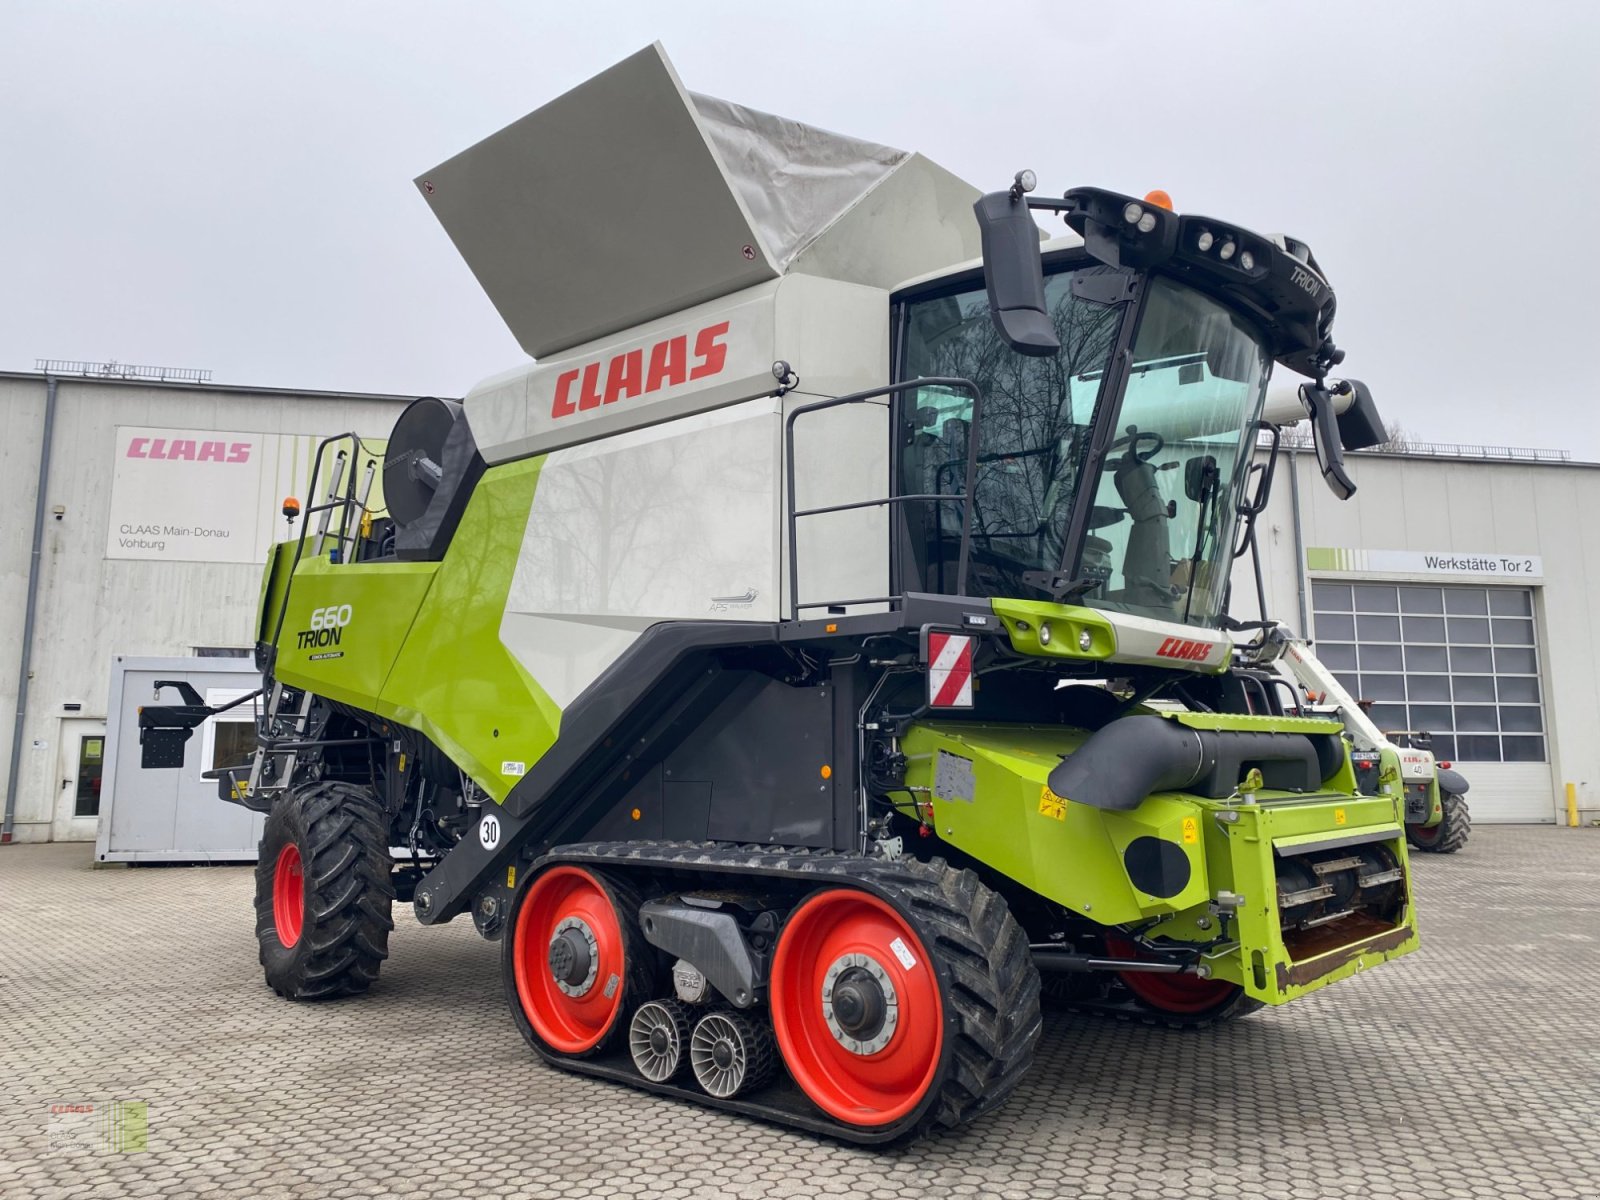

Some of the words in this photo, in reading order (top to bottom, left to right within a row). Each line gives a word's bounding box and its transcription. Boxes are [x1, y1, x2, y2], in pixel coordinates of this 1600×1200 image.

[1290, 266, 1321, 297] TRION
[552, 320, 730, 419] CLAAS
[126, 437, 252, 463] CLAAS
[120, 524, 160, 536] CLAAS
[163, 526, 230, 538] Main-Donau
[119, 538, 165, 551] Vohburg
[1425, 556, 1497, 571] Werkstätte
[1500, 559, 1520, 572] Tor
[1524, 560, 1533, 572] 2
[310, 604, 352, 631] 660
[297, 626, 342, 650] TRION
[1156, 637, 1213, 661] CLAAS
[483, 821, 496, 843] 30
